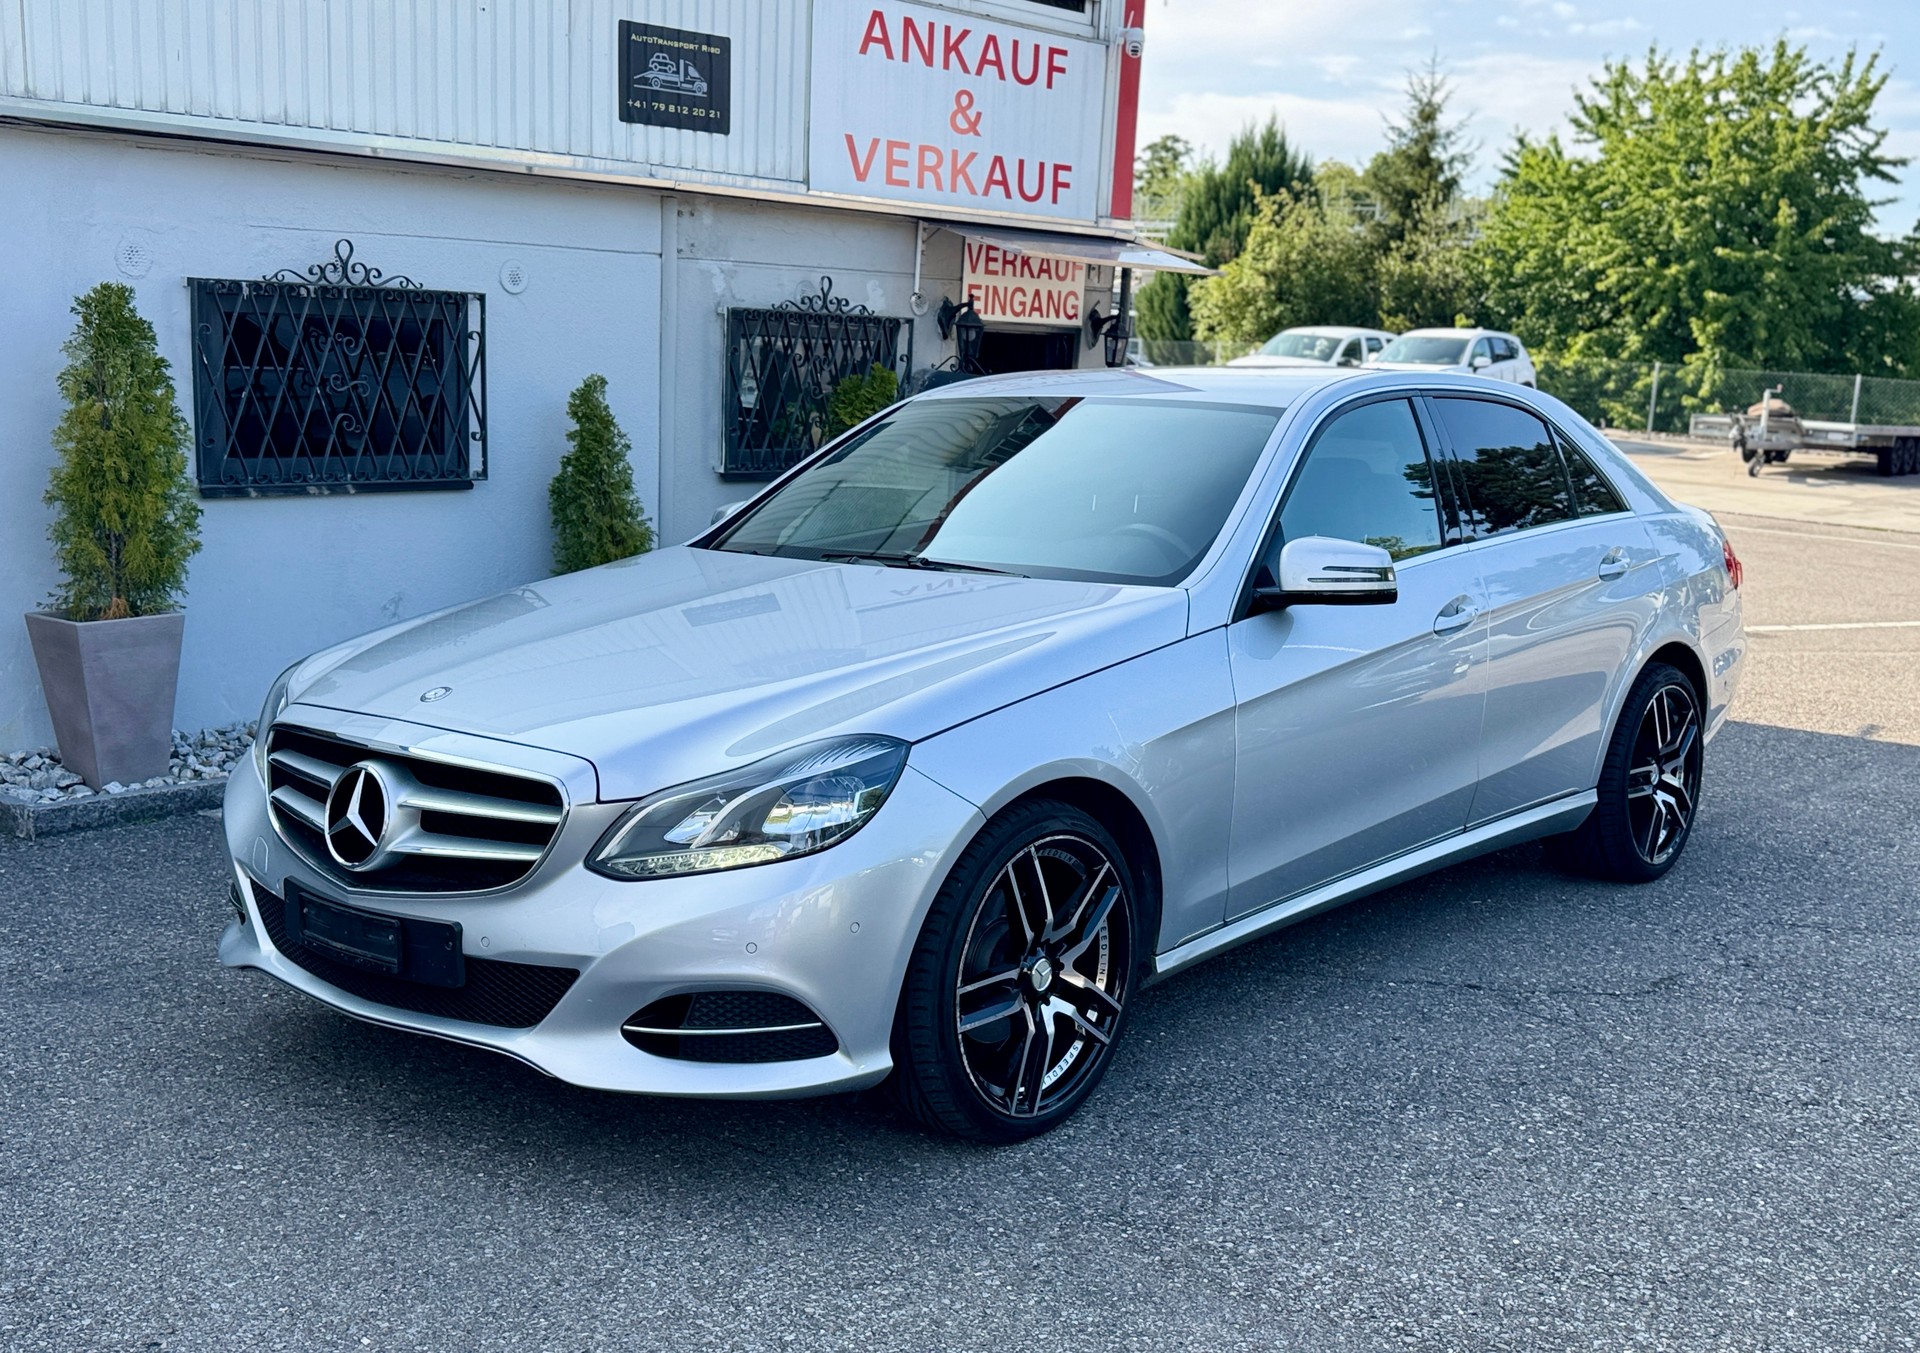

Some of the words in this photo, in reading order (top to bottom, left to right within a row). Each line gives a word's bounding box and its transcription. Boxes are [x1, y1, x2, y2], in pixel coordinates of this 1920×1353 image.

[858, 9, 1068, 90] ANKAUF
[627, 99, 647, 109] +41
[651, 102, 666, 111] 79
[668, 104, 689, 115] 812
[692, 107, 706, 117] 20
[709, 110, 721, 119] 21
[949, 89, 982, 137] &
[844, 133, 1073, 205] VERKAUF
[966, 242, 1084, 282] VERKAUF
[967, 283, 1080, 320] EINGANG
